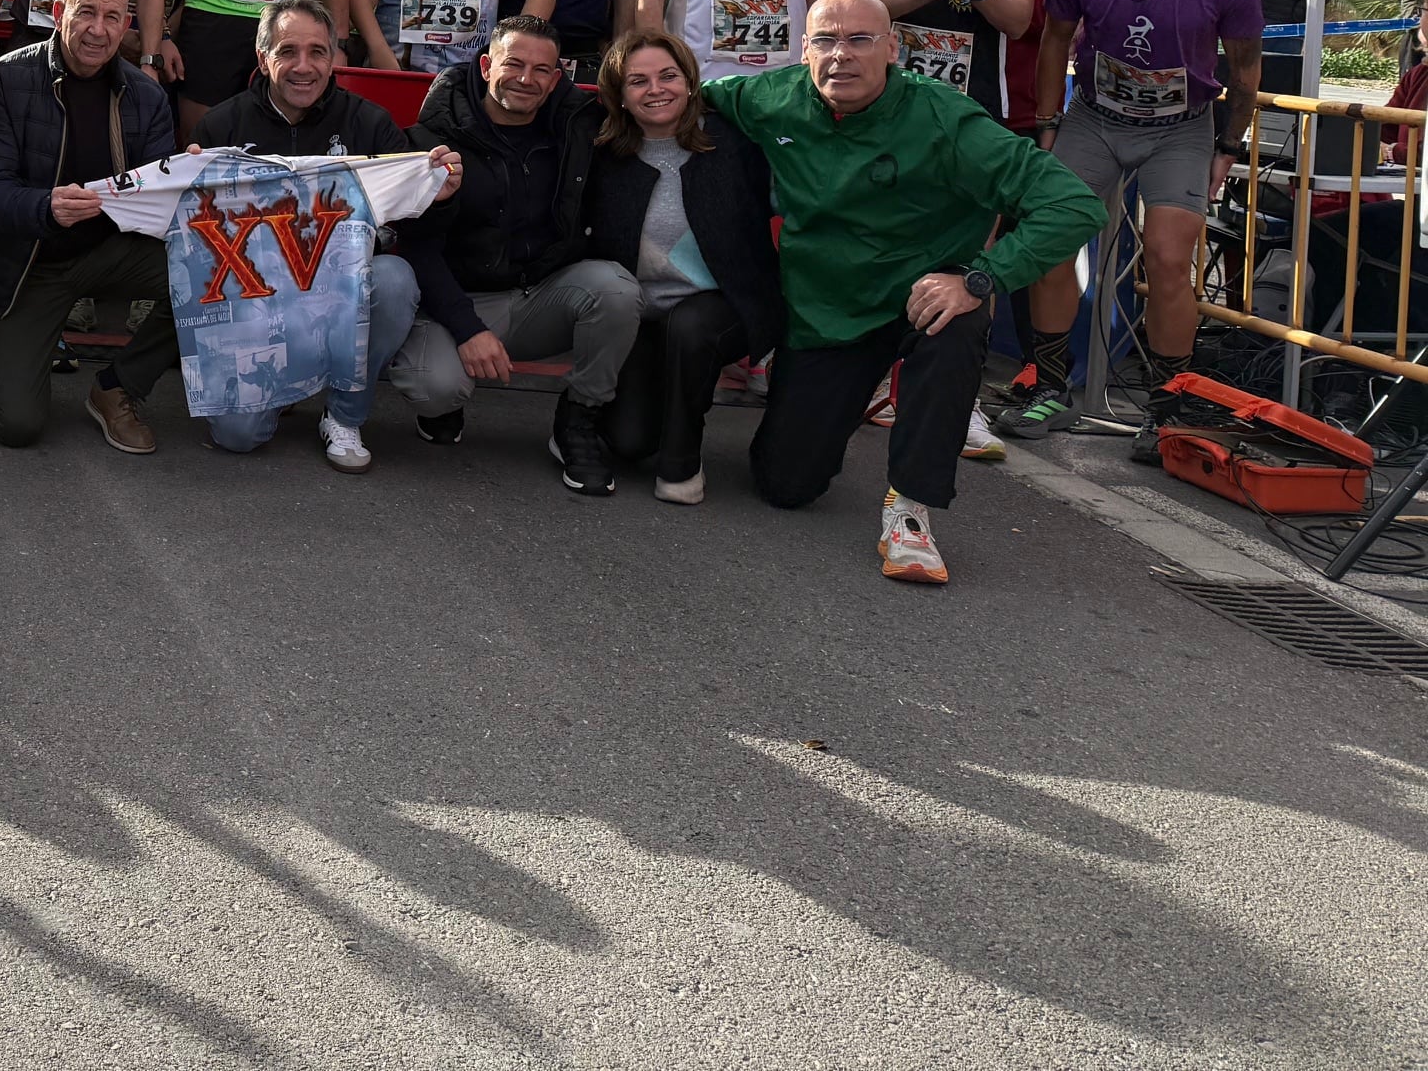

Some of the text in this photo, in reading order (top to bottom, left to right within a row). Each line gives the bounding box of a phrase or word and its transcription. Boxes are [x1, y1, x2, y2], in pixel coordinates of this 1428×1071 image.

[421, 5, 477, 27] 739
[735, 23, 789, 46] 744
[923, 30, 968, 51] XV
[910, 56, 967, 85] 676
[188, 211, 349, 303] XV
